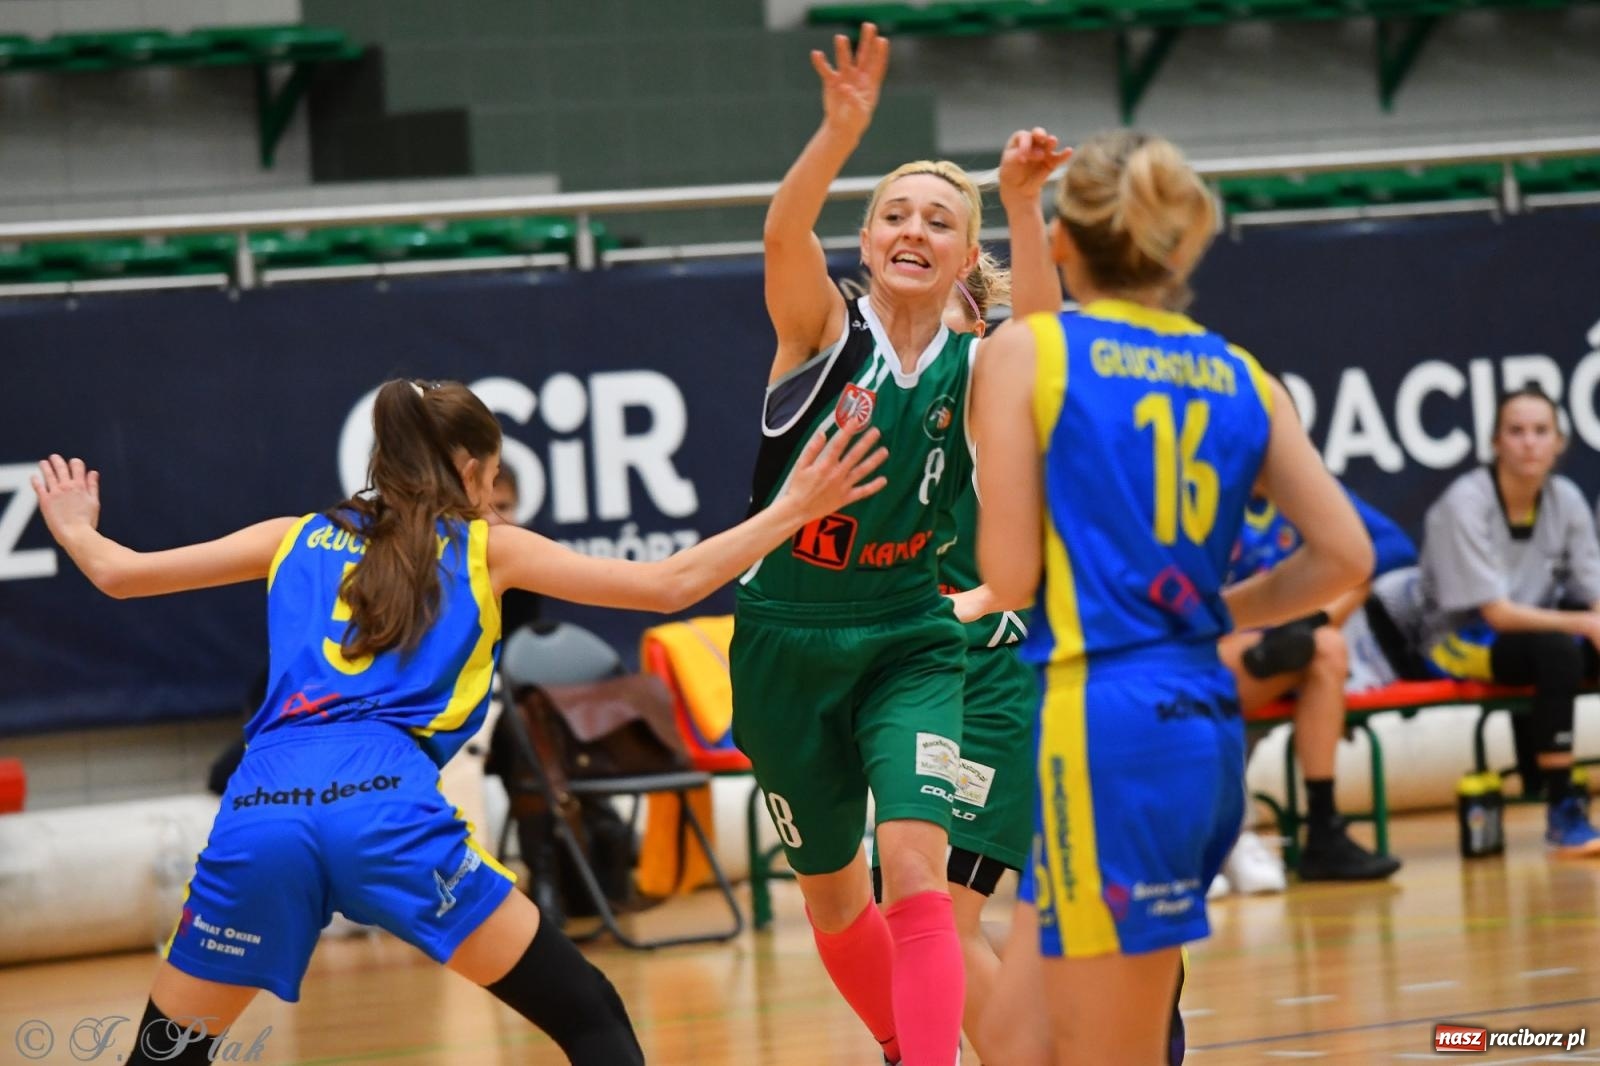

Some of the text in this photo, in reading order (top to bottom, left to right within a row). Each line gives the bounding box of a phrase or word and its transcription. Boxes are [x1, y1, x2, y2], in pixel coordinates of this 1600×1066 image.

[1134, 393, 1221, 546] 16
[858, 529, 933, 568] KAMP
[232, 775, 402, 812] schatt decor
[767, 792, 803, 848] 8
